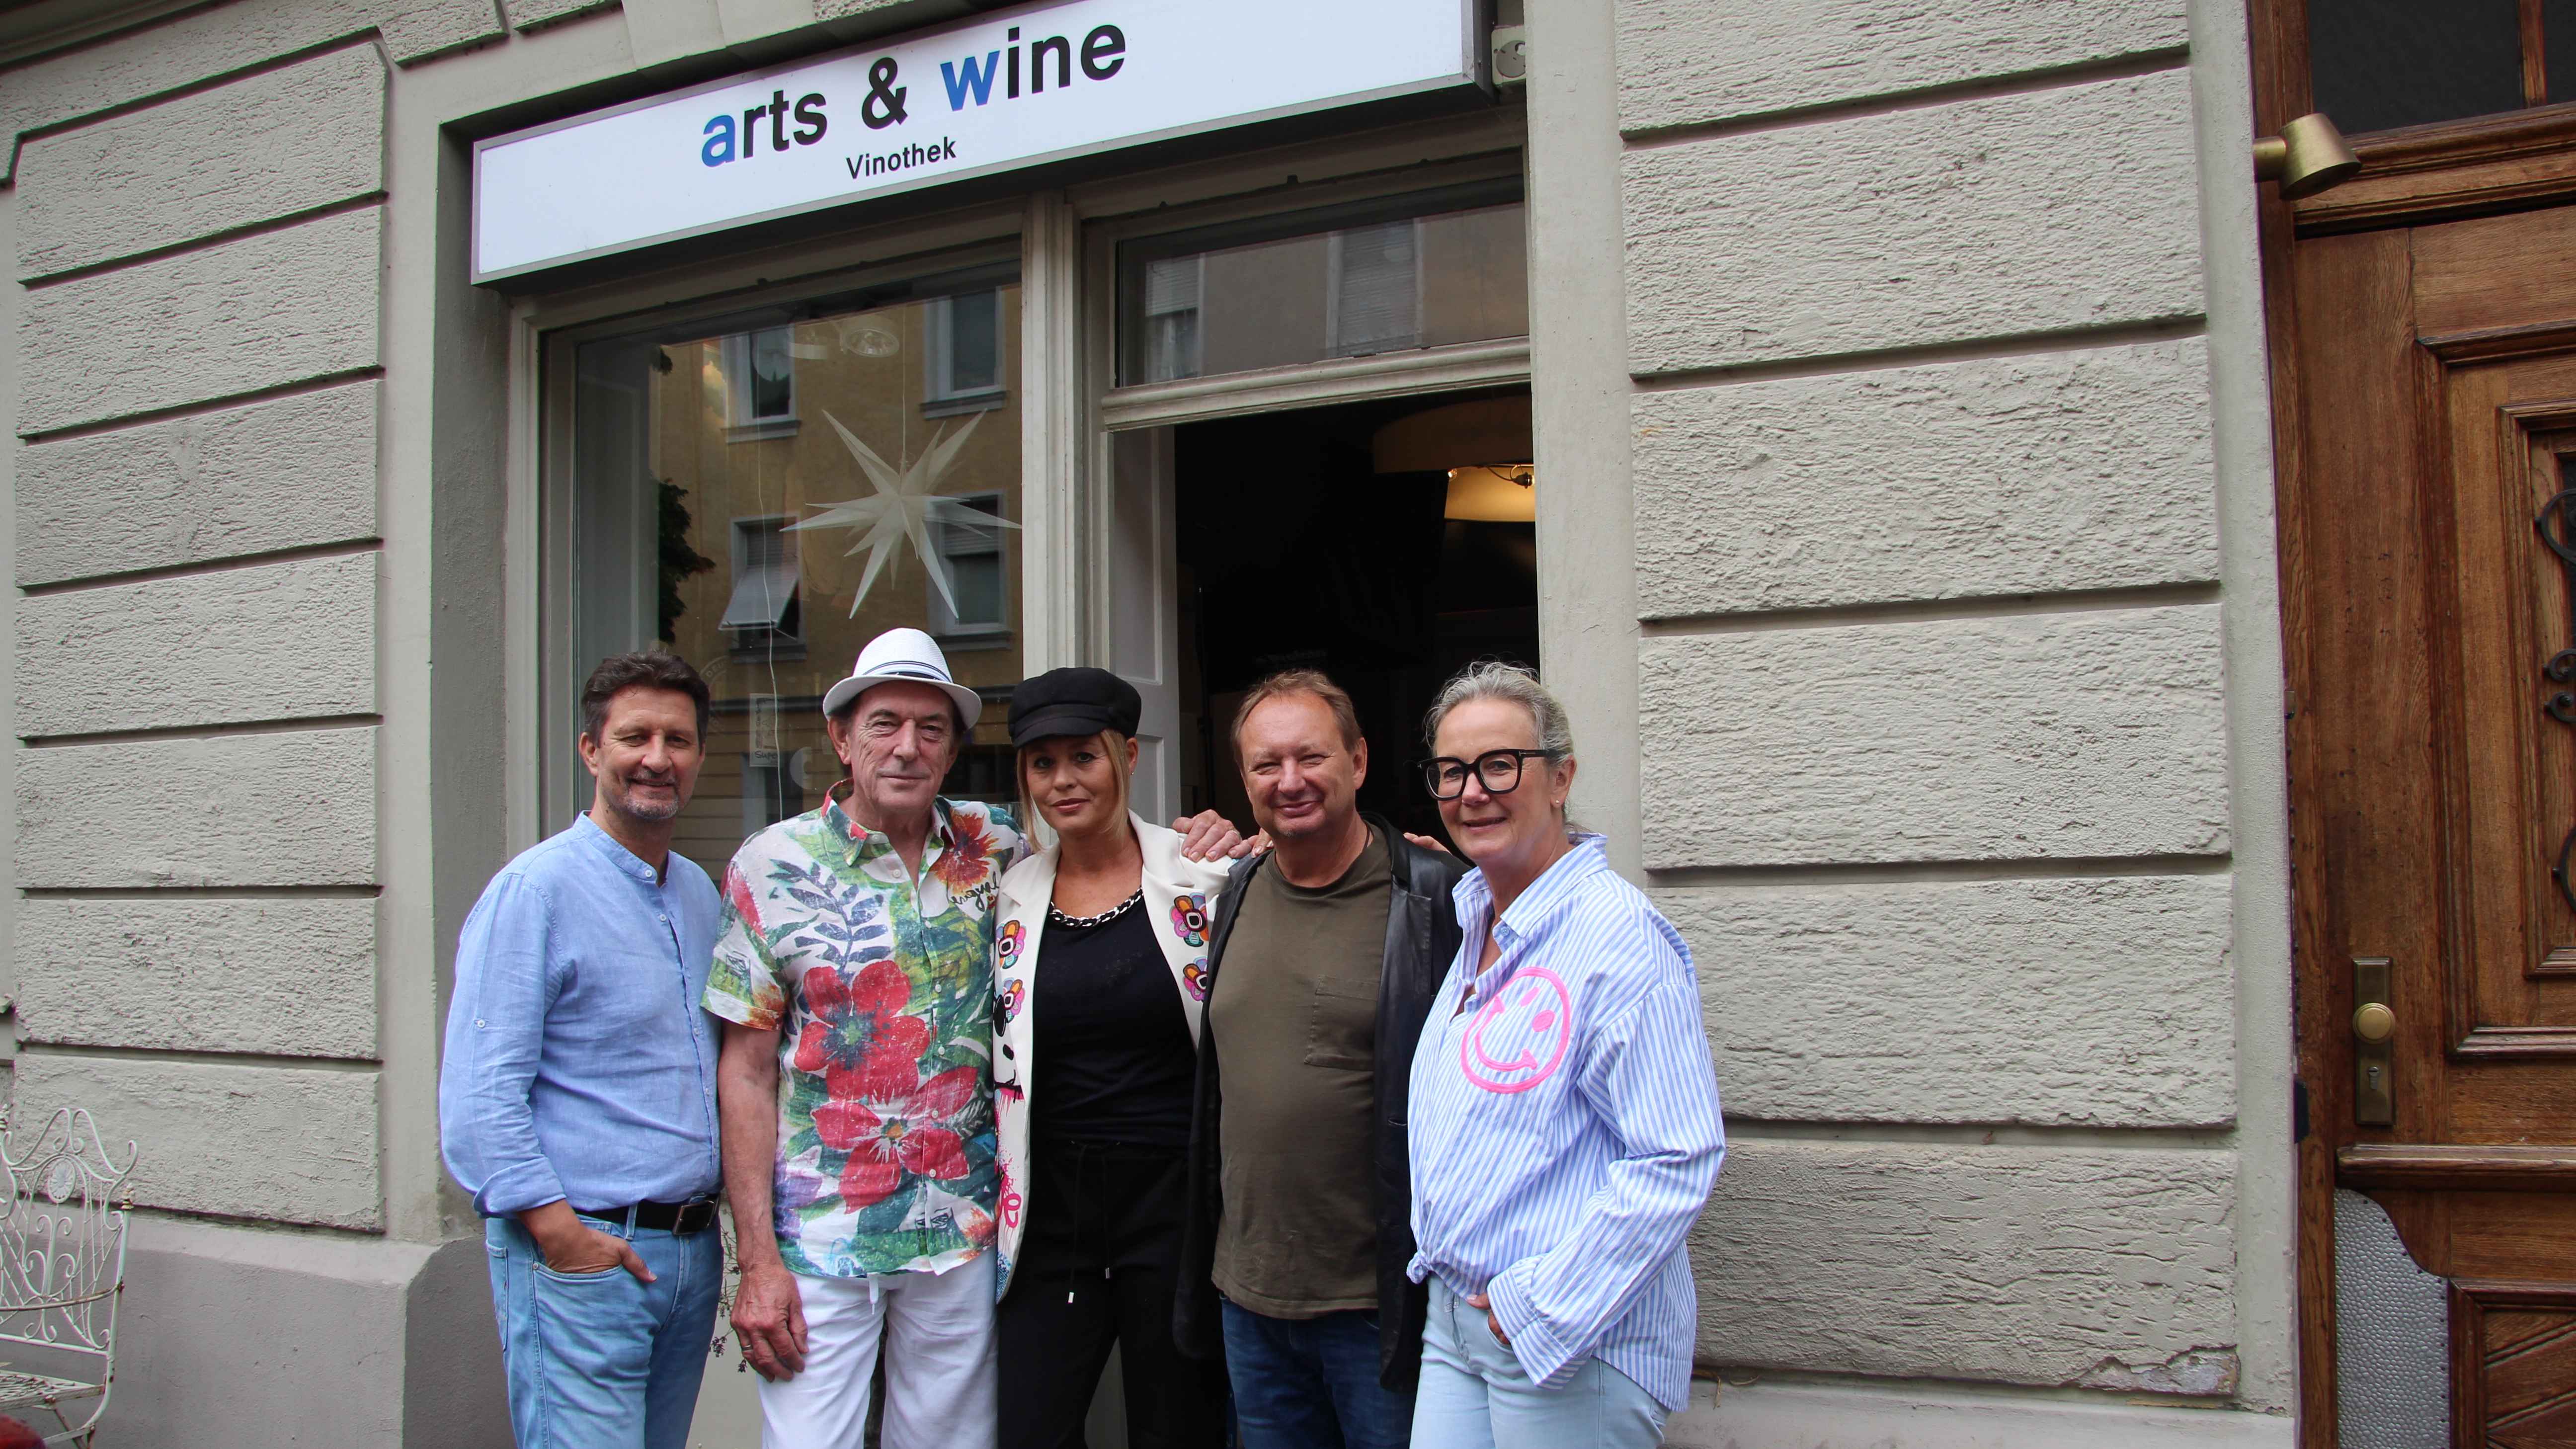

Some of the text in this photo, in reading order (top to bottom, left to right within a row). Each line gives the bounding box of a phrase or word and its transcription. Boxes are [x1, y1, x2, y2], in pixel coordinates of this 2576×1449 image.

[701, 24, 1126, 167] arts & wine
[845, 136, 957, 179] Vinothek
